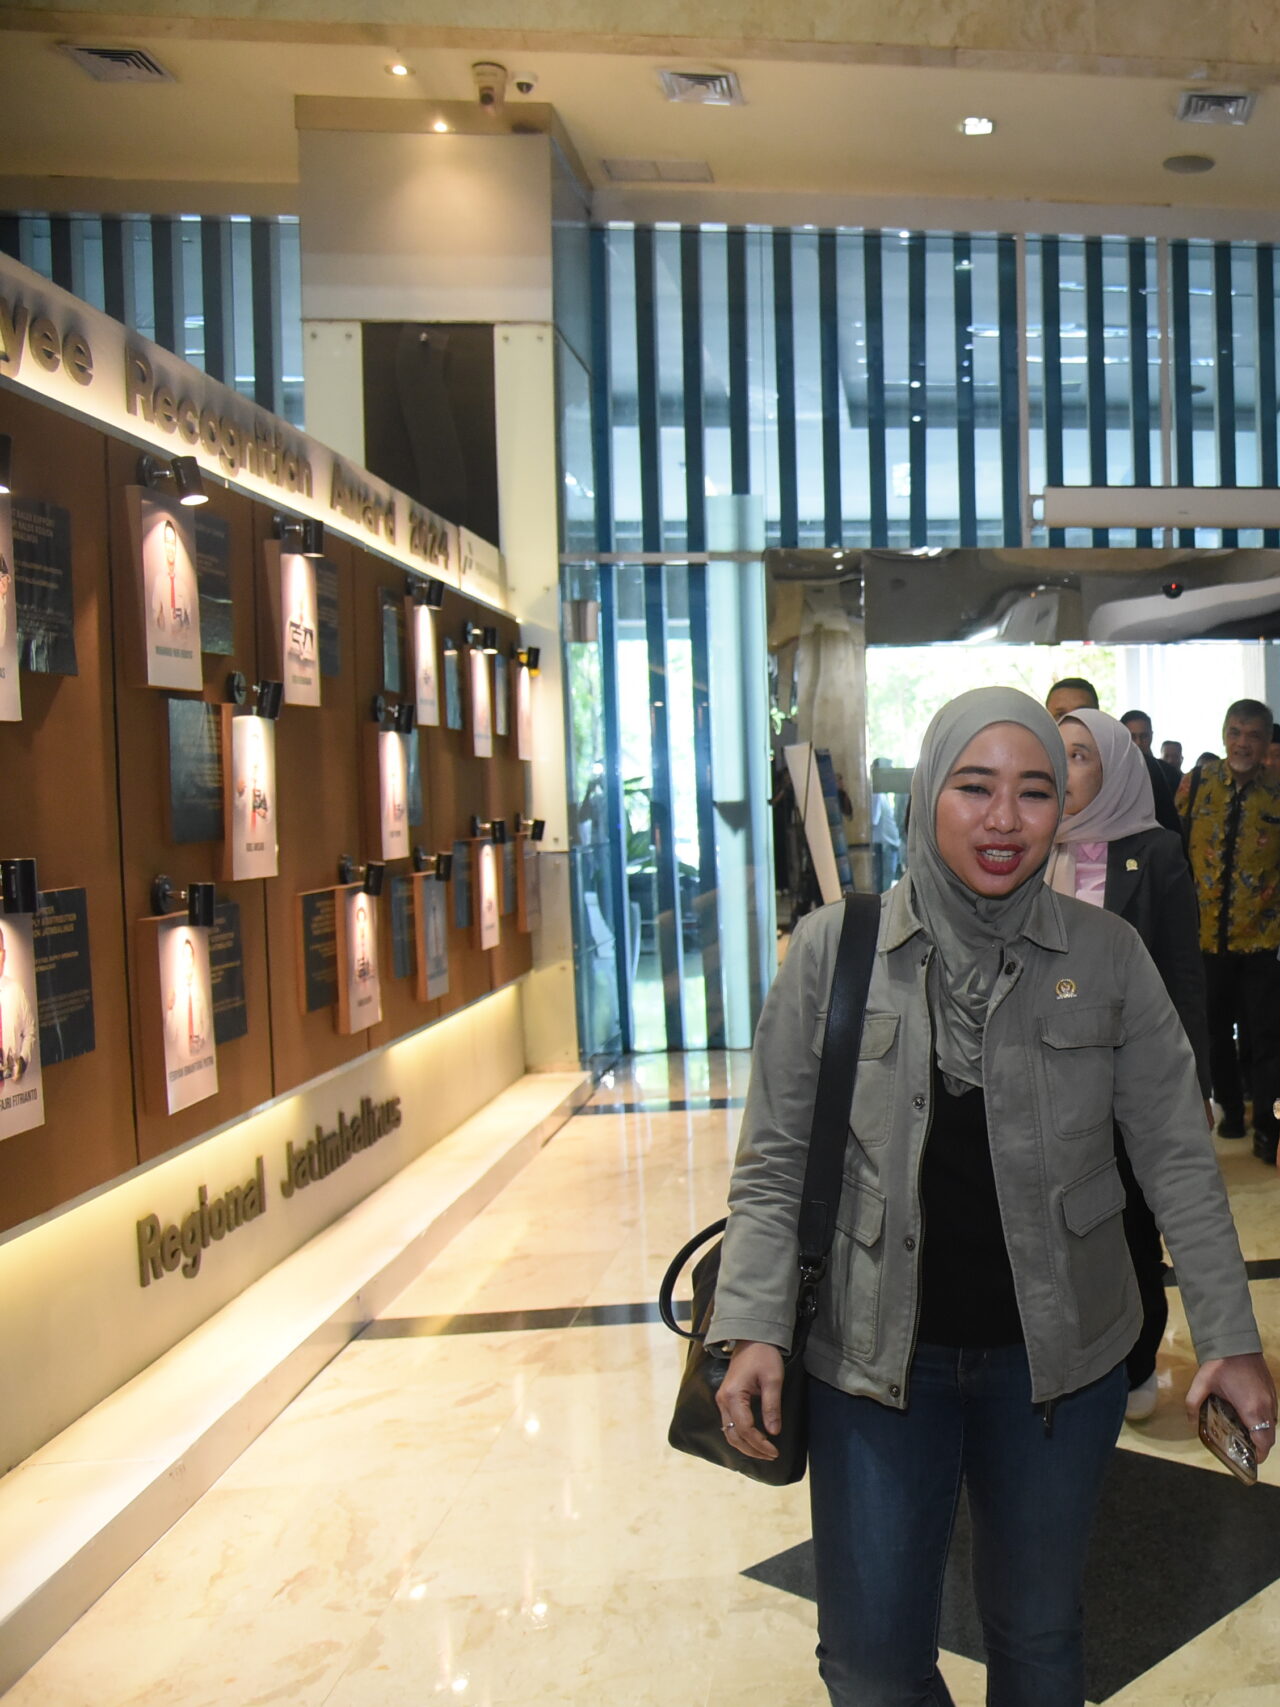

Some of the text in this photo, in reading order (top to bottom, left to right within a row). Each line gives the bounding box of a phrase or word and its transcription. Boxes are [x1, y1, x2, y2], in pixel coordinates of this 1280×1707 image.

[125, 341, 314, 500] Recognition
[330, 462, 396, 545] Award
[409, 510, 450, 571] 2024
[136, 1155, 266, 1288] Regional
